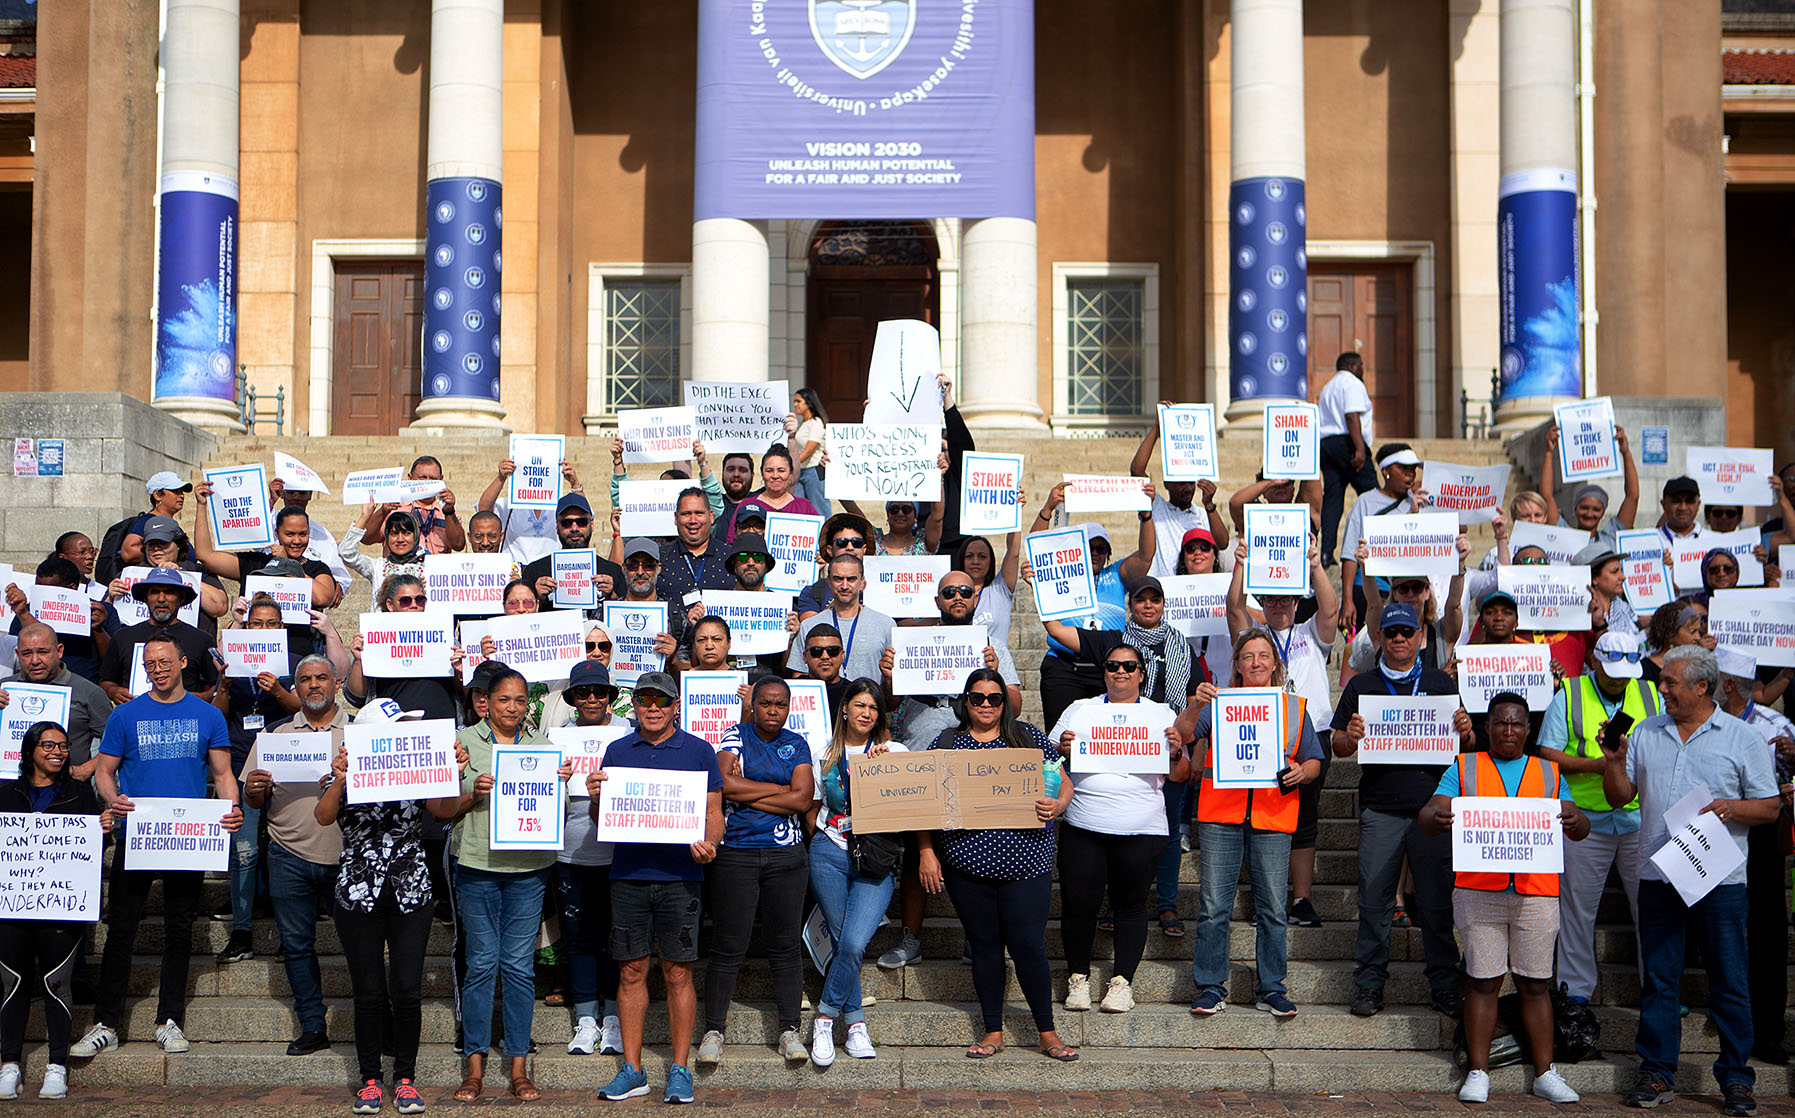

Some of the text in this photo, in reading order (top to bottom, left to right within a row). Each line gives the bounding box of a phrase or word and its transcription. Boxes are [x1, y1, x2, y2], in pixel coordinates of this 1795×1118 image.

[760, 39, 780, 67] van
[806, 143, 921, 156] VISION 2030
[769, 160, 954, 170] UNLEASH HUMAN POTENTIAL
[766, 173, 961, 184] FOR A FAIR AND JUST SOCIETY
[692, 386, 772, 398] DID THE EXEC
[698, 403, 772, 414] CONVINCE YOU
[723, 417, 736, 425] WE
[760, 416, 786, 426] BEING
[1275, 415, 1309, 428] SHAME
[1580, 423, 1592, 432] ON
[832, 426, 927, 446] WHO'S GOING
[1284, 430, 1298, 443] ON
[1573, 432, 1602, 446] STRIKE
[838, 443, 917, 457] TO PROCESS
[1282, 445, 1301, 458] UCT
[1581, 445, 1597, 457] FOR
[531, 456, 543, 466] ON
[1571, 456, 1610, 471] EQUALITY
[523, 466, 550, 477] STRIKE
[844, 461, 873, 478] YOUR
[528, 478, 543, 488] FOR
[865, 472, 926, 497] NOW?
[972, 472, 1012, 487] STRIKE
[517, 489, 554, 501] EQUALITY
[968, 489, 1016, 505] WITH US
[223, 496, 252, 508] END THE
[229, 508, 250, 518] STAFF
[222, 517, 261, 529] APARTHEID
[1254, 536, 1300, 548] ON STRIKE
[1369, 533, 1454, 545] GOOD FAITH BARGAINING
[1269, 549, 1286, 561] FOR
[1371, 545, 1452, 558] BASIC LABOUR LAW
[1035, 549, 1082, 567] UCT STOP
[556, 562, 591, 571] BARGAINING
[573, 572, 583, 580] NOT
[1037, 564, 1085, 582] BULLYING
[1268, 567, 1290, 579] 7.5%
[558, 580, 590, 588] DIVIDE AND
[1056, 582, 1070, 594] US
[567, 588, 581, 596] RULE
[228, 643, 248, 653] DOWN
[249, 643, 266, 653] WITH
[906, 646, 973, 657] WE ONLY WANT A
[244, 653, 266, 663] DOWN!
[900, 658, 980, 669] GOLDEN HAND SHAKE
[926, 670, 955, 680] OF 7.5%
[1226, 705, 1269, 722] SHAME
[138, 733, 198, 745] UNLEASH
[1091, 726, 1148, 740] UNDERPAID
[1239, 725, 1256, 742] ON
[371, 736, 431, 753] UCT BE THE
[1080, 742, 1161, 756] & UNDERVALUED
[263, 752, 327, 762] EEN DRAG MAAK MAG
[1236, 744, 1260, 761] UCT
[357, 752, 447, 770] TRENDSETTER IN
[859, 762, 935, 777] WORLD CLASS
[1009, 762, 1037, 773] CLASS
[353, 768, 452, 788] STAFF PROMOTION
[502, 782, 554, 797] ON STRIKE
[880, 785, 927, 797] UNIVERSITY
[992, 785, 1011, 796] PAY
[518, 798, 537, 812] FOR
[35, 817, 59, 829] BUT
[63, 817, 87, 828] PASS
[518, 818, 542, 832] 7.5%
[1462, 810, 1551, 829] BARGAINING
[137, 822, 220, 836] WE ARE FORCE TO
[6, 833, 39, 847] CAN'T
[42, 835, 71, 846] COME
[1463, 831, 1554, 846] IS NOT A TICK BOX
[1698, 835, 1711, 851] the
[130, 838, 224, 852] BE RECKONED WITH
[1, 851, 34, 862] PHONE
[39, 851, 68, 863] RIGHT
[1481, 845, 1534, 861] EXERCISE!
[10, 866, 44, 878] WHY?
[21, 880, 74, 891] THEY ARE
